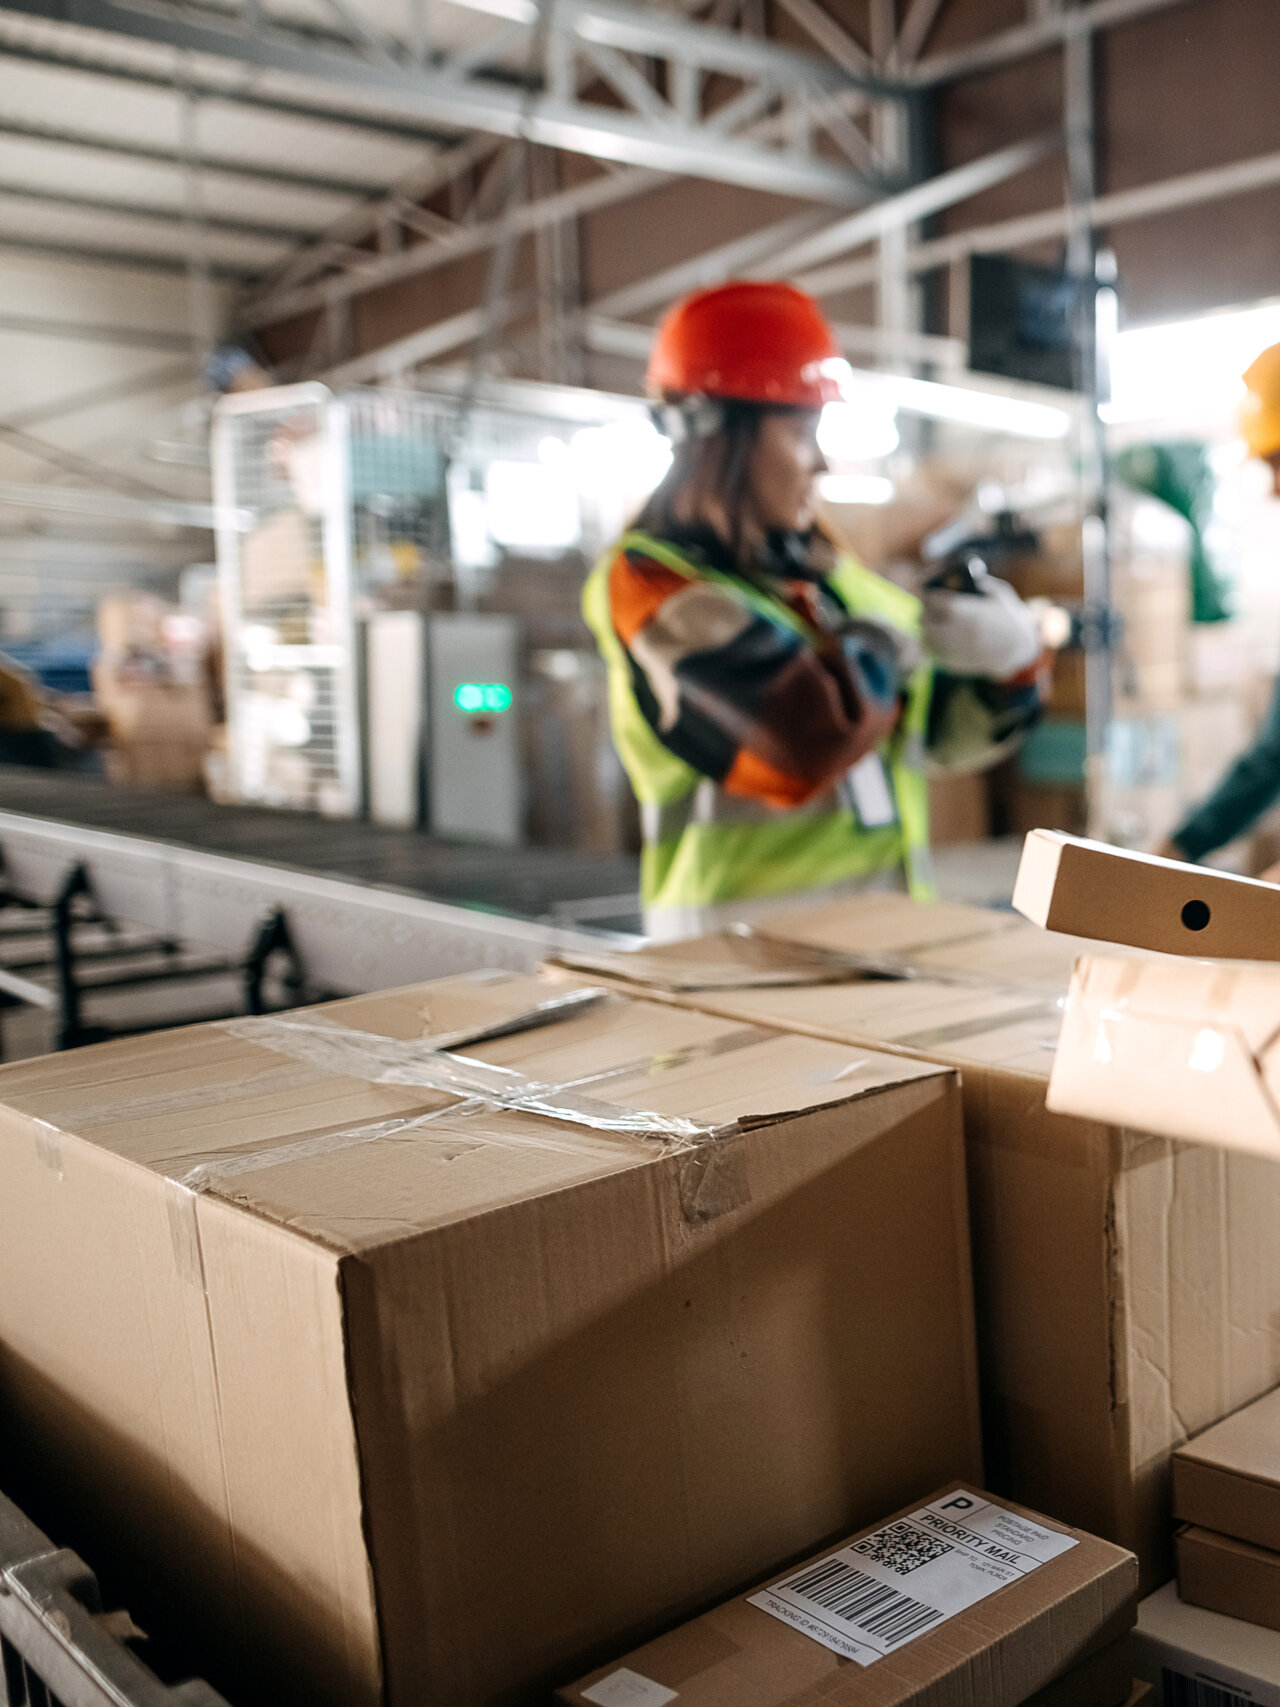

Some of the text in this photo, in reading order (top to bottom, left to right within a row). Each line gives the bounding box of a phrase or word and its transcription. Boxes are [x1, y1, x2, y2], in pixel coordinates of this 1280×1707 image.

[940, 1497, 973, 1510] P
[920, 1514, 1020, 1564] PRIORITY MAIL
[765, 1600, 801, 1622] TRACKING
